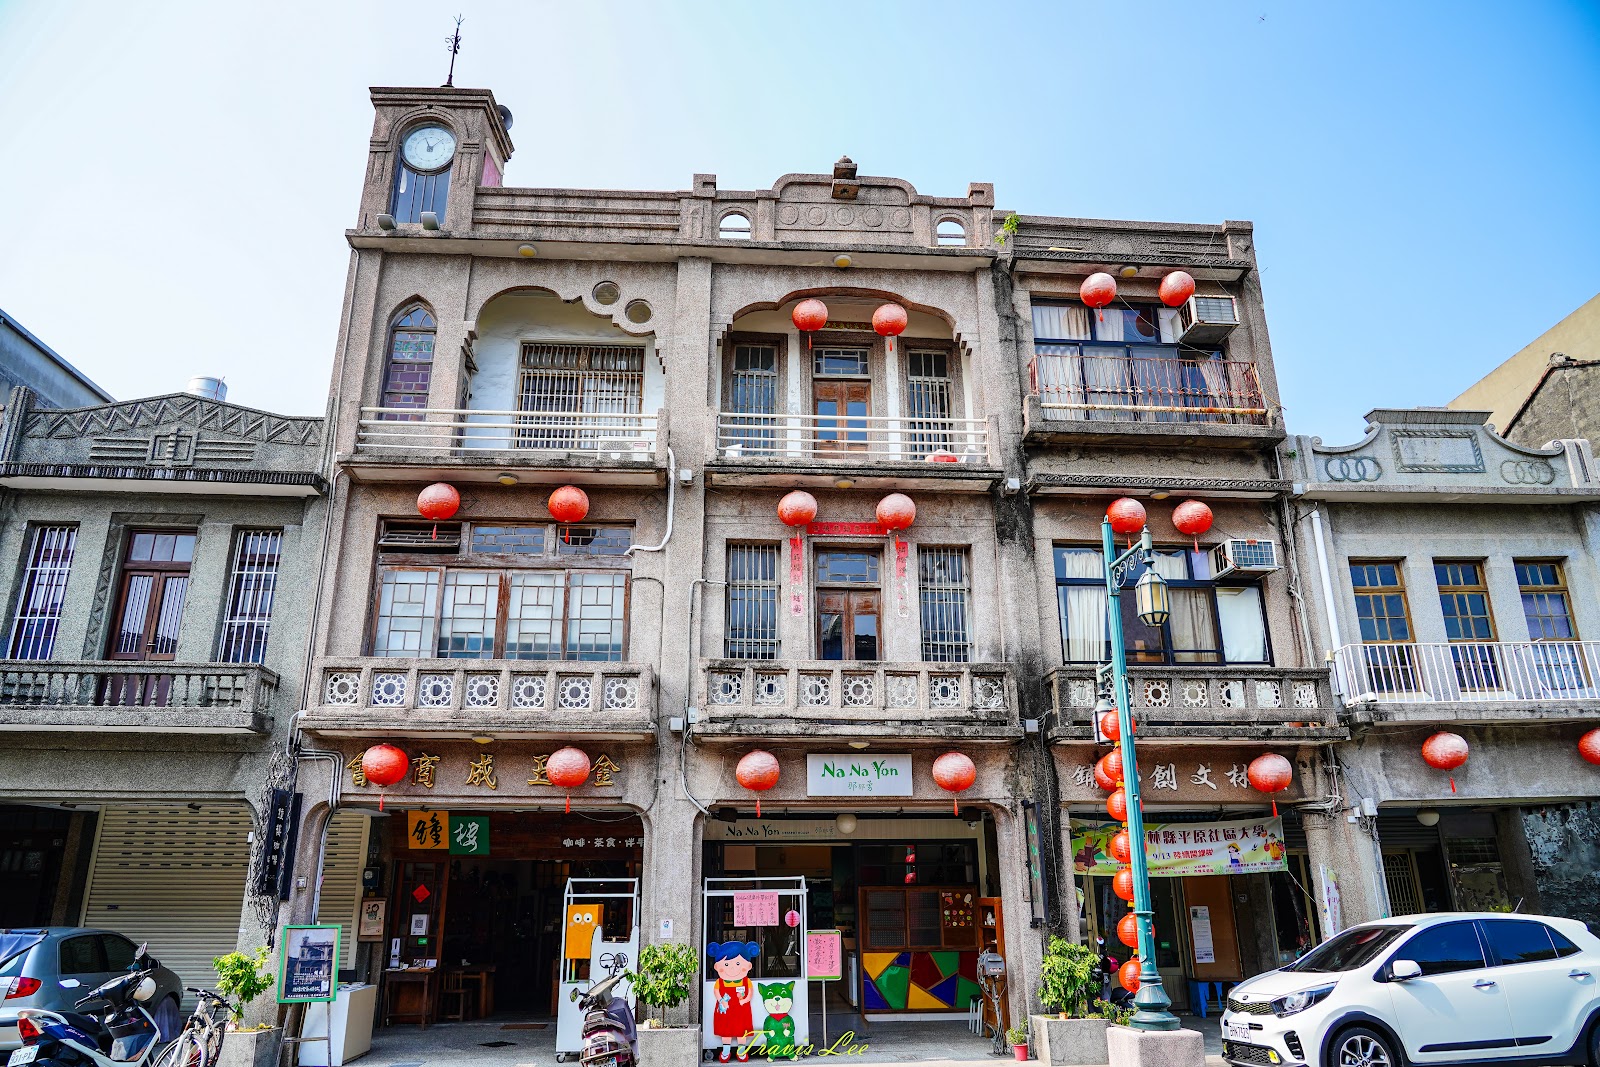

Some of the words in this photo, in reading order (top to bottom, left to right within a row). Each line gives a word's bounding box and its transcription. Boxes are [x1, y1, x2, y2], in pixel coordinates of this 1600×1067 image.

[821, 760, 845, 778] Na
[849, 762, 869, 777] Na
[871, 759, 899, 779] Yon
[726, 824, 742, 837] Na
[745, 826, 759, 836] Na
[761, 824, 780, 837] Yon
[1144, 825, 1264, 845] 林縣平原社區大學
